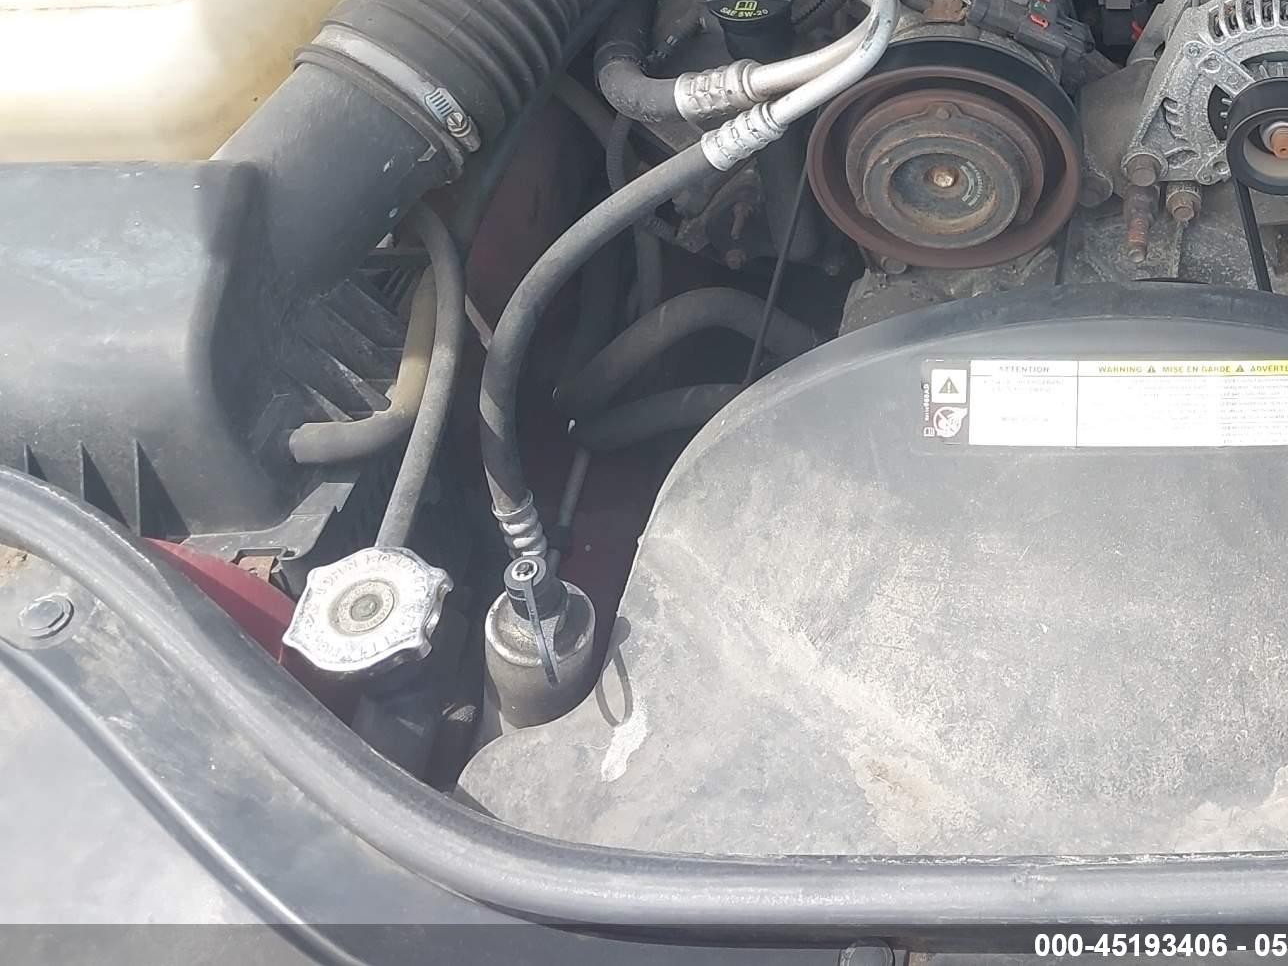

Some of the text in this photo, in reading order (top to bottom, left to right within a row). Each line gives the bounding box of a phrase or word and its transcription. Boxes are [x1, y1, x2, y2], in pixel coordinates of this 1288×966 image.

[720, 7, 769, 18] SAE 5W-20
[999, 365, 1050, 374] ATTENTION
[1098, 365, 1142, 374] WARNING
[1162, 365, 1184, 373] MISE
[1186, 365, 1198, 373] EN
[1201, 364, 1231, 373] GARDE
